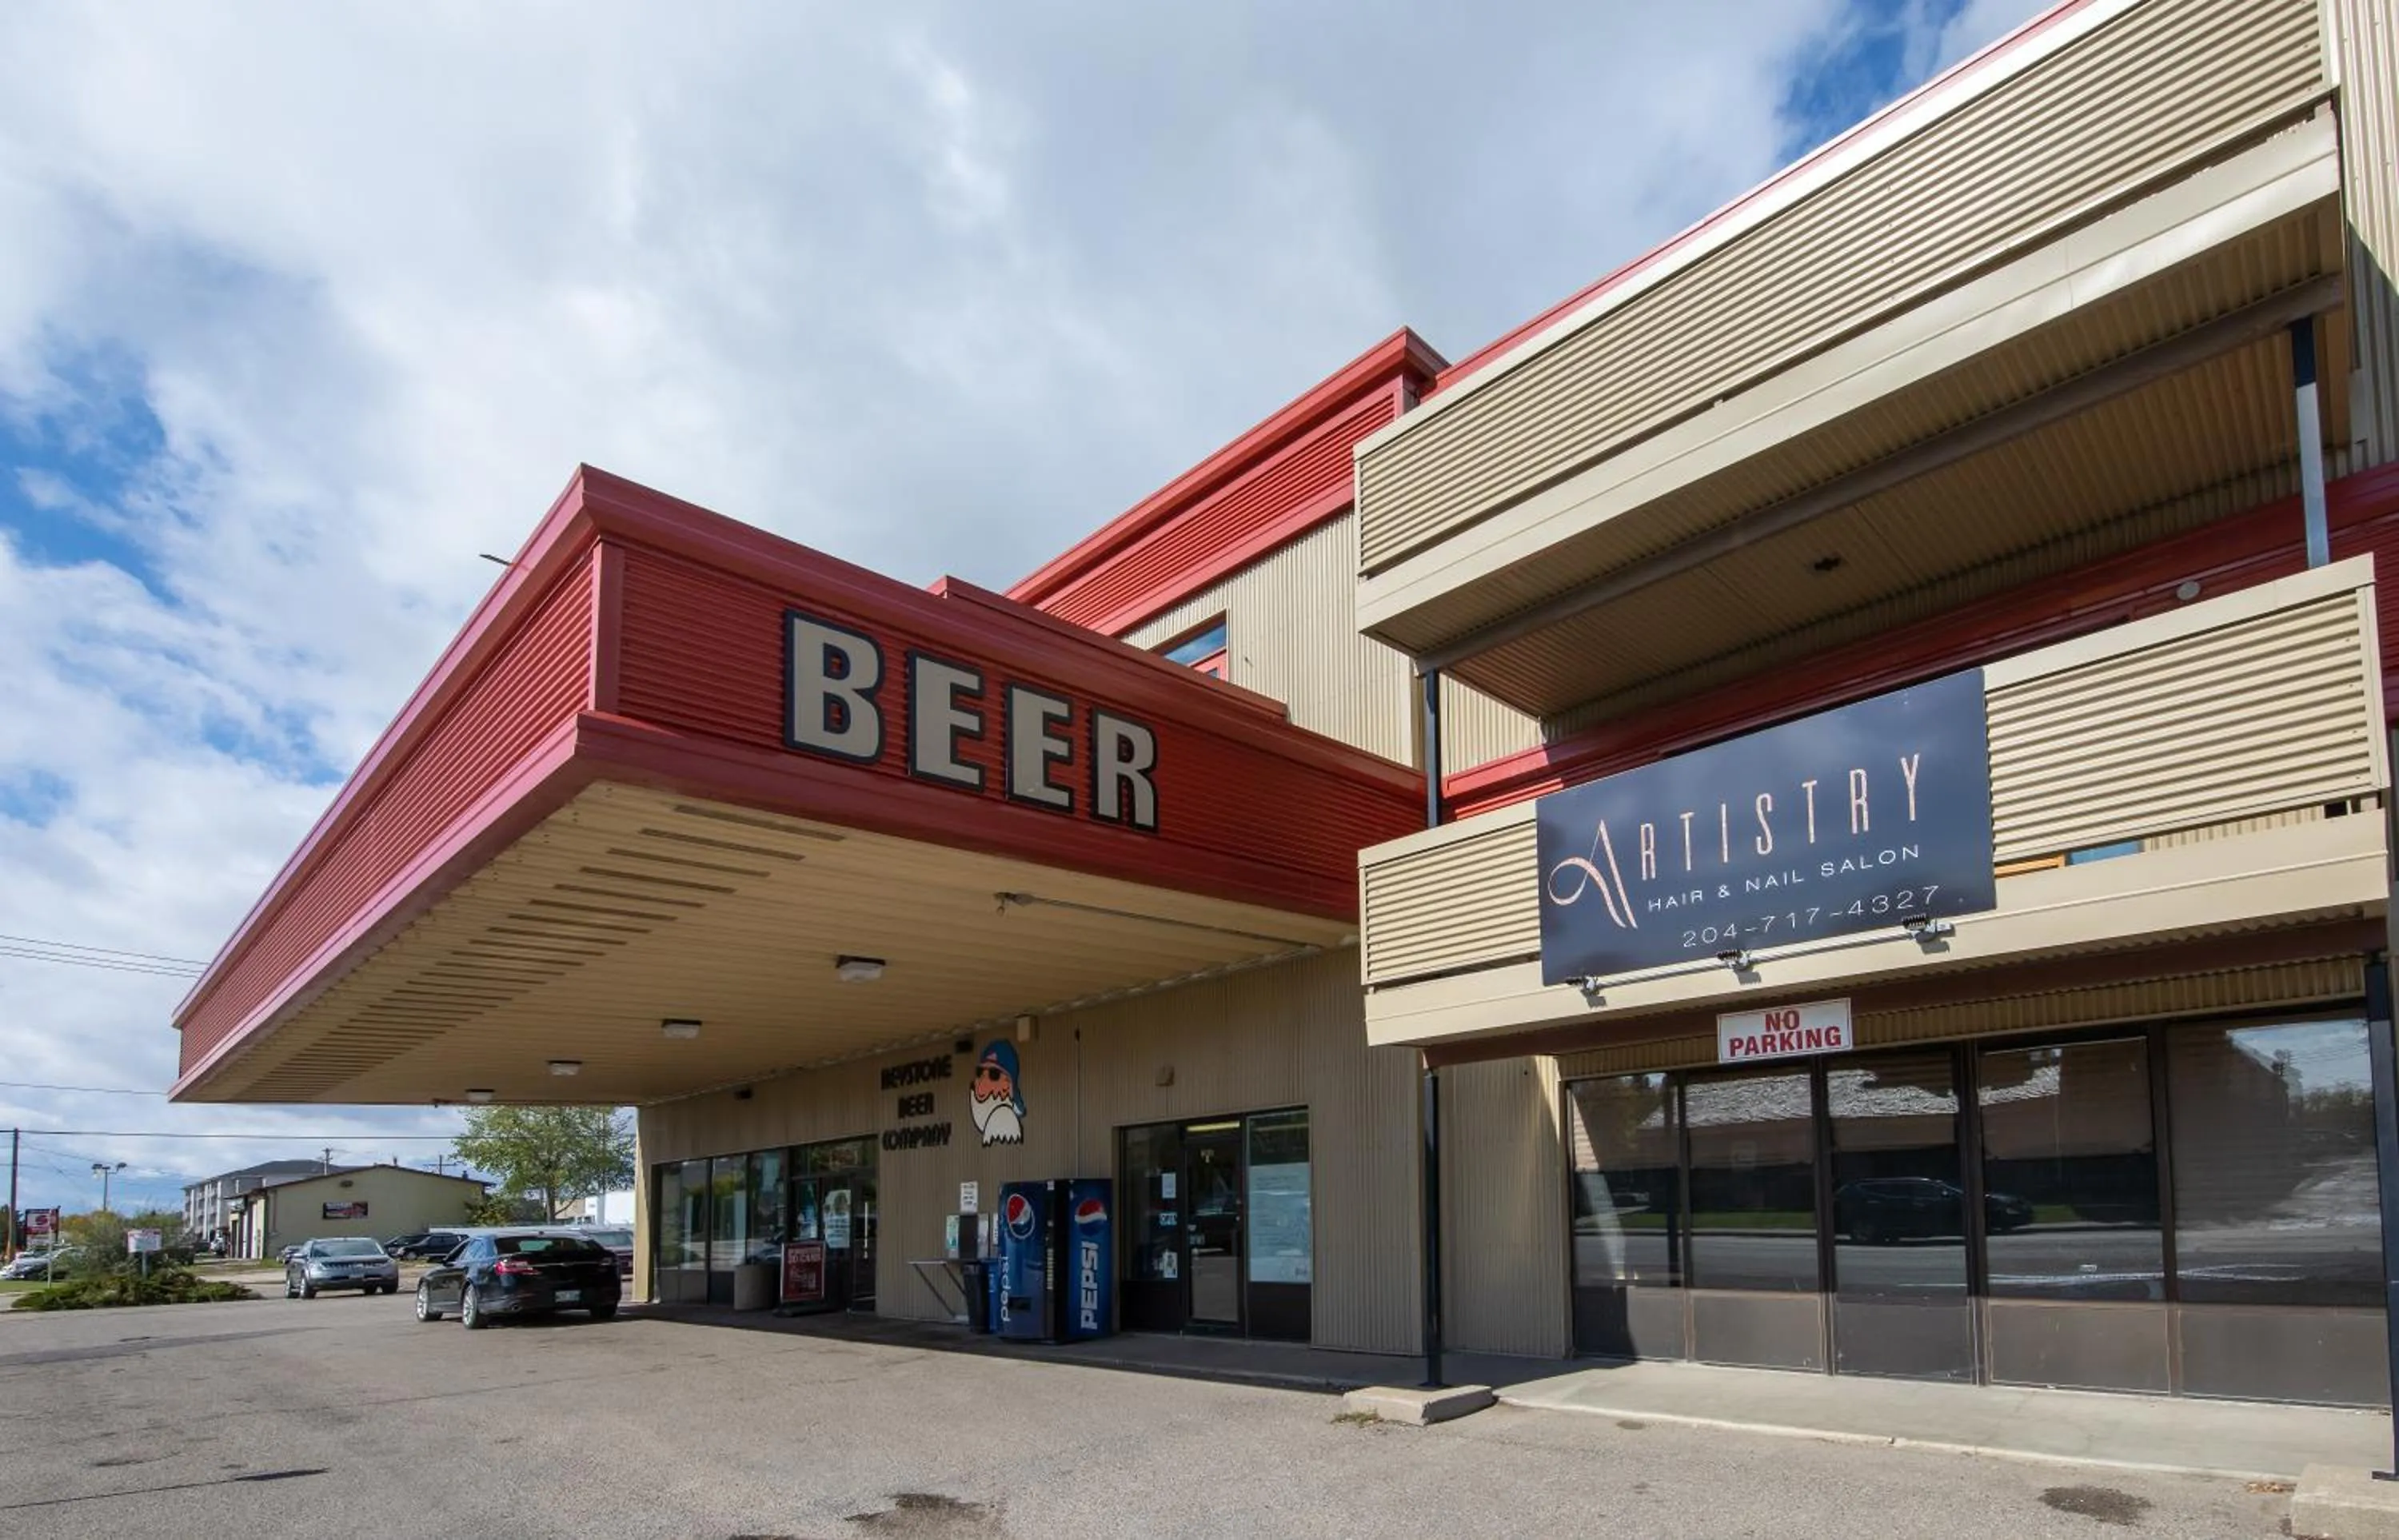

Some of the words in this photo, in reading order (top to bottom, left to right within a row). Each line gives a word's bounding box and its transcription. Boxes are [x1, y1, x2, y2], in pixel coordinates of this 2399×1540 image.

[784, 610, 1158, 832] BEER
[1548, 754, 1919, 930] ARTISTRY
[1648, 889, 1703, 913] HAIR
[1718, 884, 1731, 899] &
[1745, 869, 1805, 893] NAIL
[1820, 844, 1919, 877] SALON
[1682, 885, 1940, 948] 204-717-4327
[1729, 1026, 1842, 1057] PARKING
[1765, 1010, 1800, 1033] NO
[882, 1122, 952, 1151] COMPANY
[1000, 1256, 1012, 1323] pepsi
[1080, 1241, 1099, 1331] PEPSI
